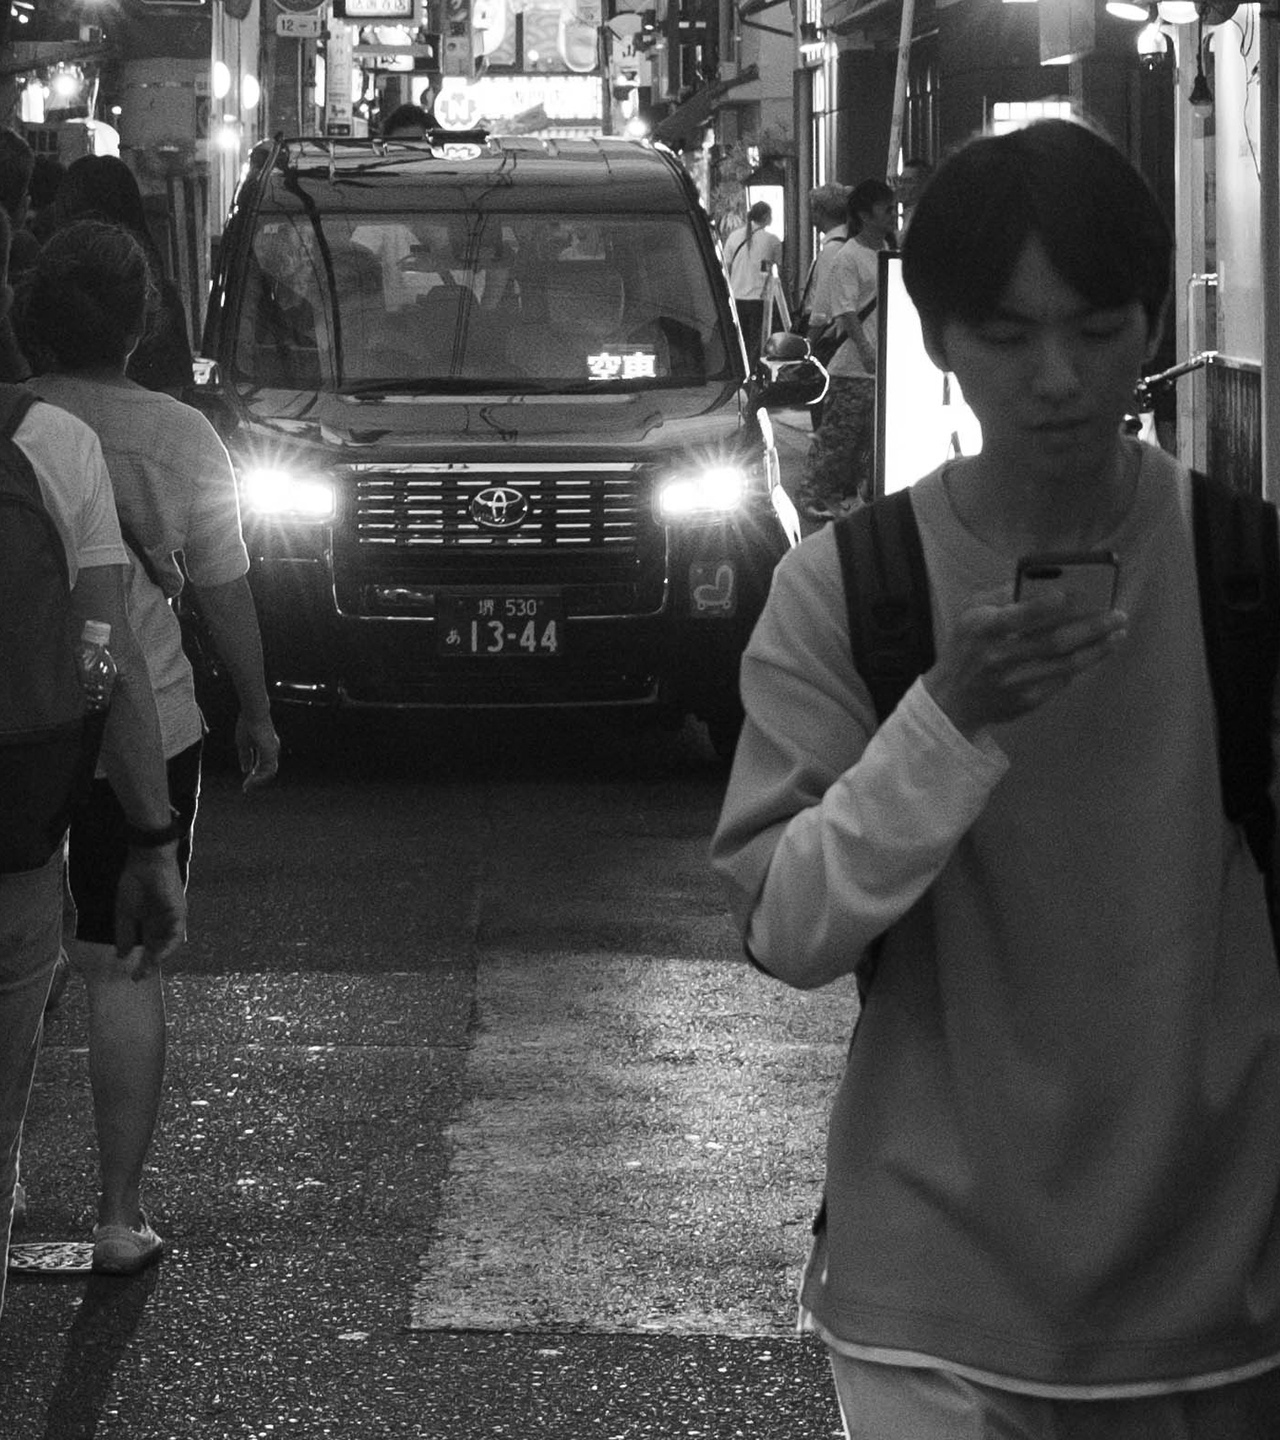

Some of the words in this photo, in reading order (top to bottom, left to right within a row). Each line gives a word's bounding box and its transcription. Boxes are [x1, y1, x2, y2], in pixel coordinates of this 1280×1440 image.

[587, 351, 657, 380] 空車
[505, 599, 537, 616] 530
[446, 627, 461, 646] あ
[471, 620, 558, 653] 13-44
